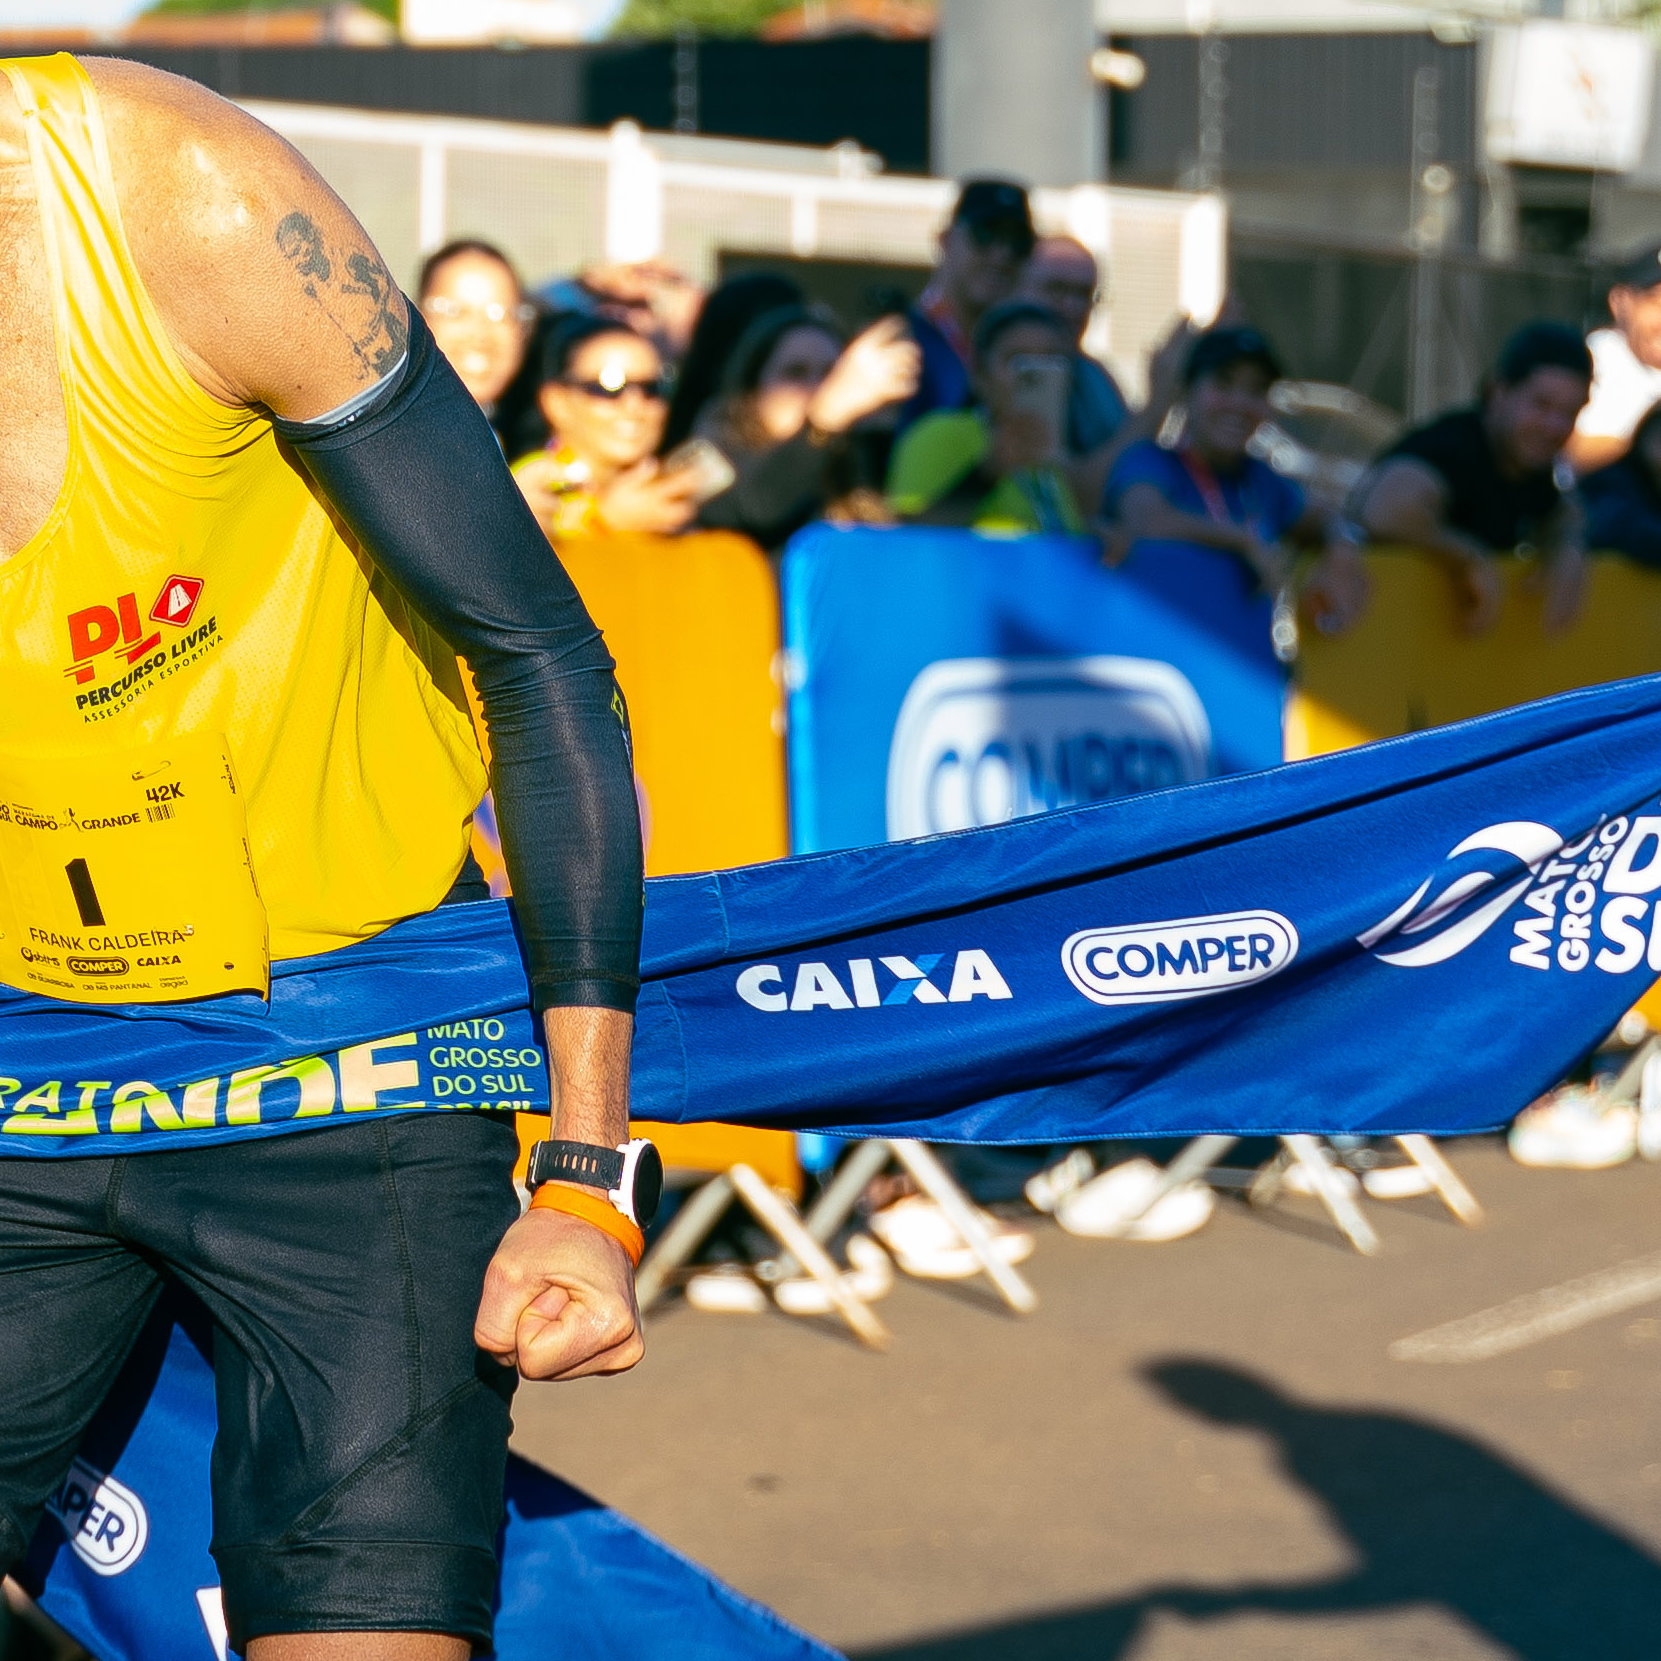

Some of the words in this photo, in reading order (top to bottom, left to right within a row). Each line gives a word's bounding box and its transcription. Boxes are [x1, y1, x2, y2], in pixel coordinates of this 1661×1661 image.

[75, 651, 167, 710] PERCURSO
[172, 616, 218, 659] LIVRE
[84, 679, 155, 724] ASSESSORIA
[159, 634, 224, 680] ESPORTIVA
[145, 781, 186, 804] 42K
[15, 814, 58, 831] CAMPO
[82, 813, 142, 830] GRANDE
[64, 858, 107, 927] 1
[1557, 815, 1630, 972] GROSSO
[29, 926, 85, 951] FRANK
[88, 928, 187, 951] CALDEIRA
[70, 958, 125, 973] COMPER
[136, 955, 182, 967] CAIXA
[1084, 934, 1276, 981] COMPER
[735, 947, 1014, 1012] CAIXA
[427, 1018, 505, 1041] MATO
[429, 1046, 541, 1068] GROSSO
[432, 1075, 477, 1097] DO
[481, 1073, 535, 1094] SUL
